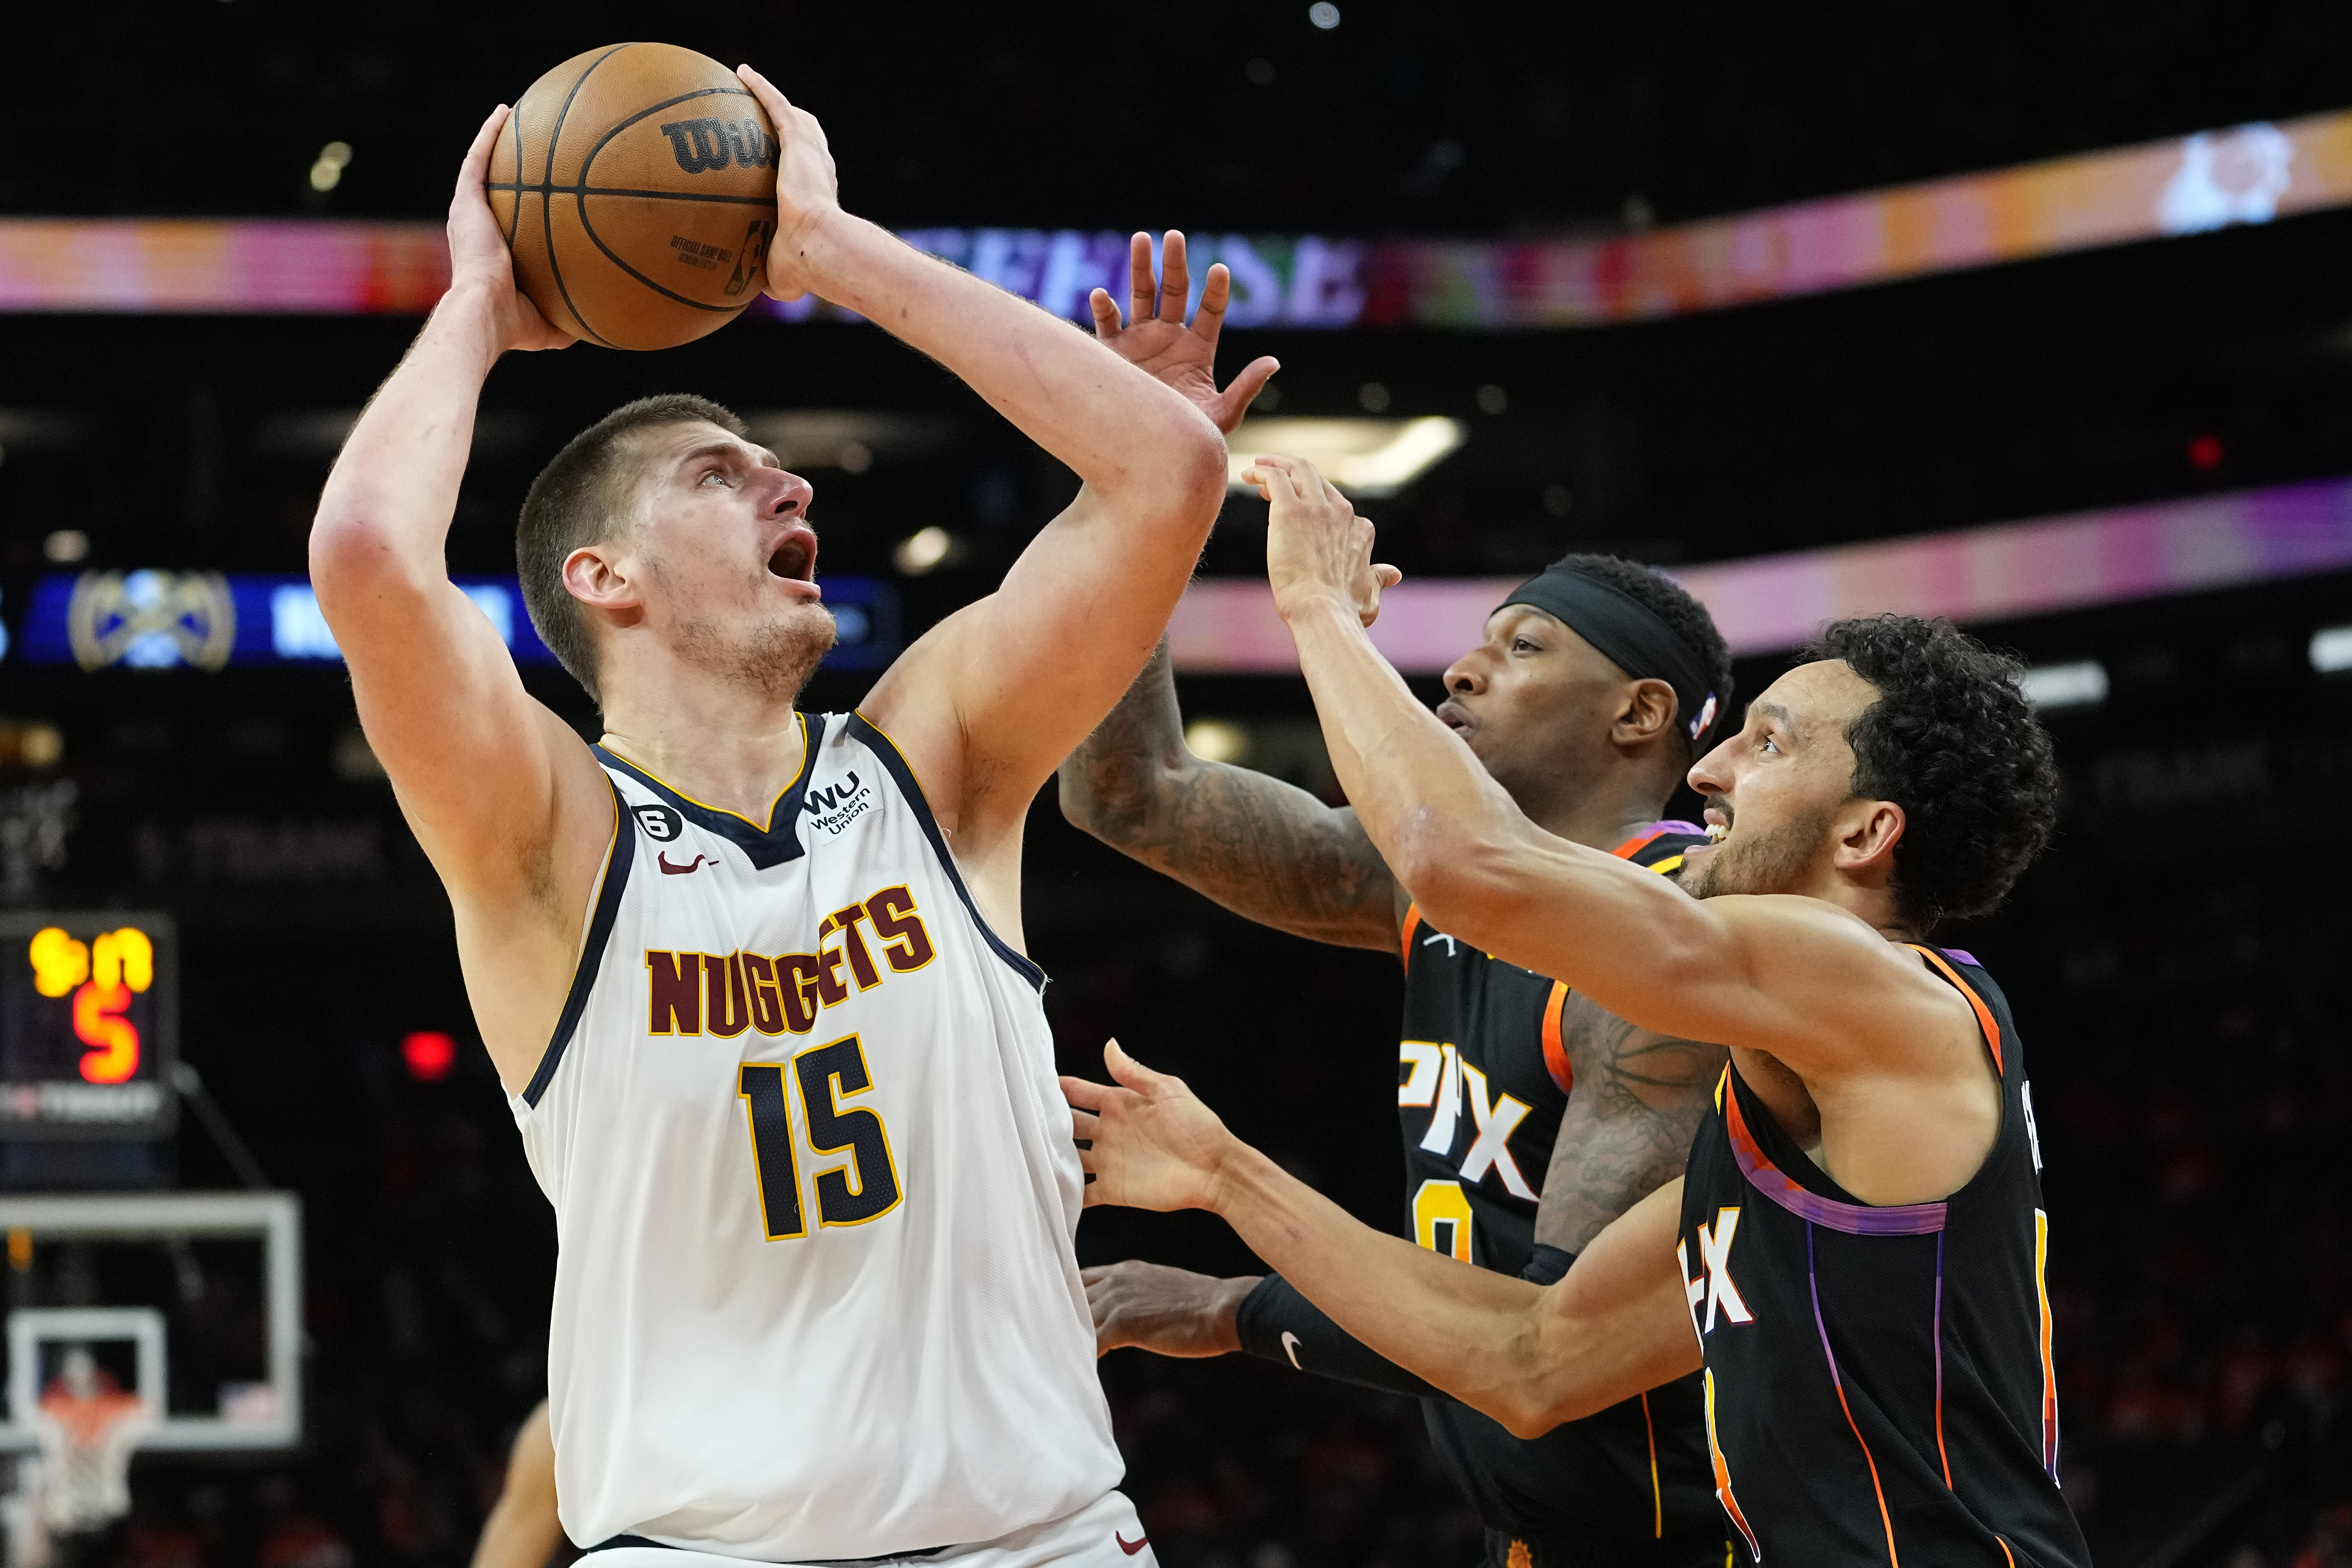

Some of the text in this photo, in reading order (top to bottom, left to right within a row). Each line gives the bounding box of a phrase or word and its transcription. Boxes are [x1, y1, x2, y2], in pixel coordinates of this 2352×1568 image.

[671, 235, 733, 263] OFFICIAL GAME BALL
[804, 771, 859, 815] WU
[810, 788, 871, 829] Western
[639, 811, 669, 838] 6
[828, 802, 869, 834] Union
[645, 883, 937, 1039] NUGGETS
[737, 1032, 904, 1242] 15
